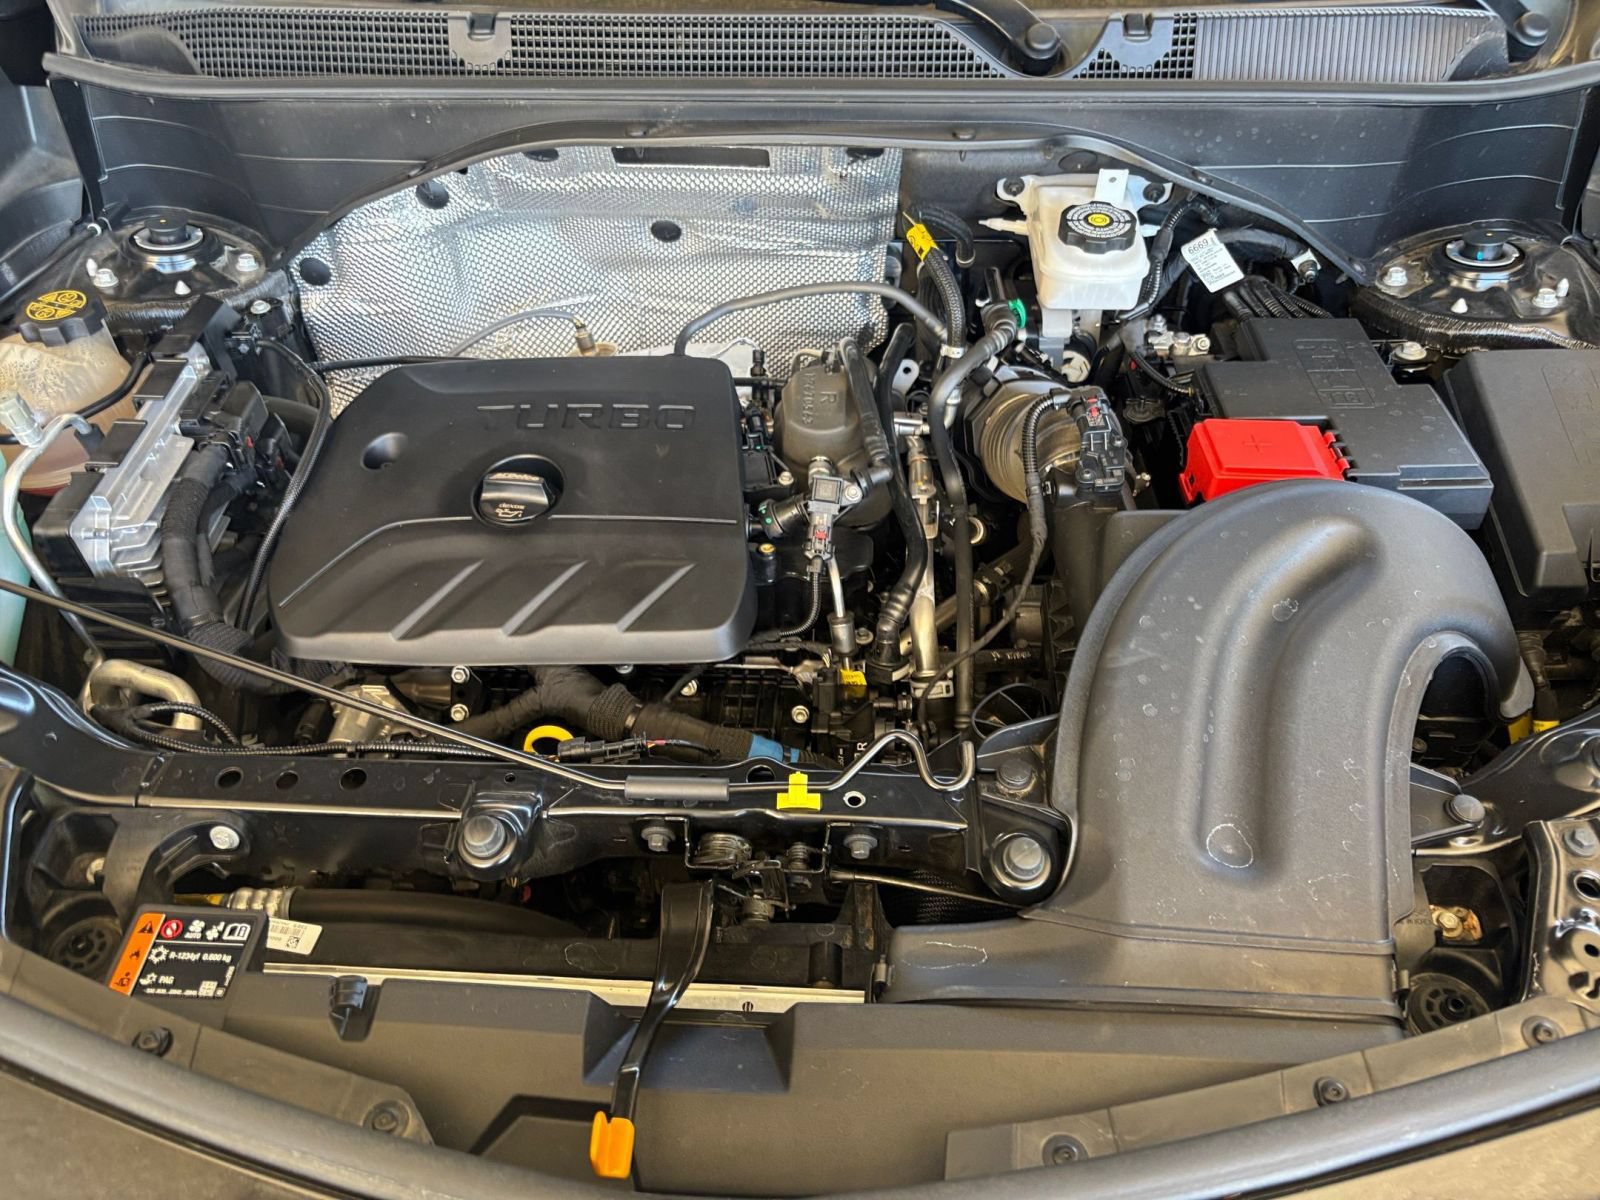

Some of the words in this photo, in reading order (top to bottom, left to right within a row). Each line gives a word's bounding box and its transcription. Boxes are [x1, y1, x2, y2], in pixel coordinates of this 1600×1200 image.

[477, 403, 696, 432] TURBO
[222, 953, 232, 963] kg
[158, 975, 175, 985] PAG
